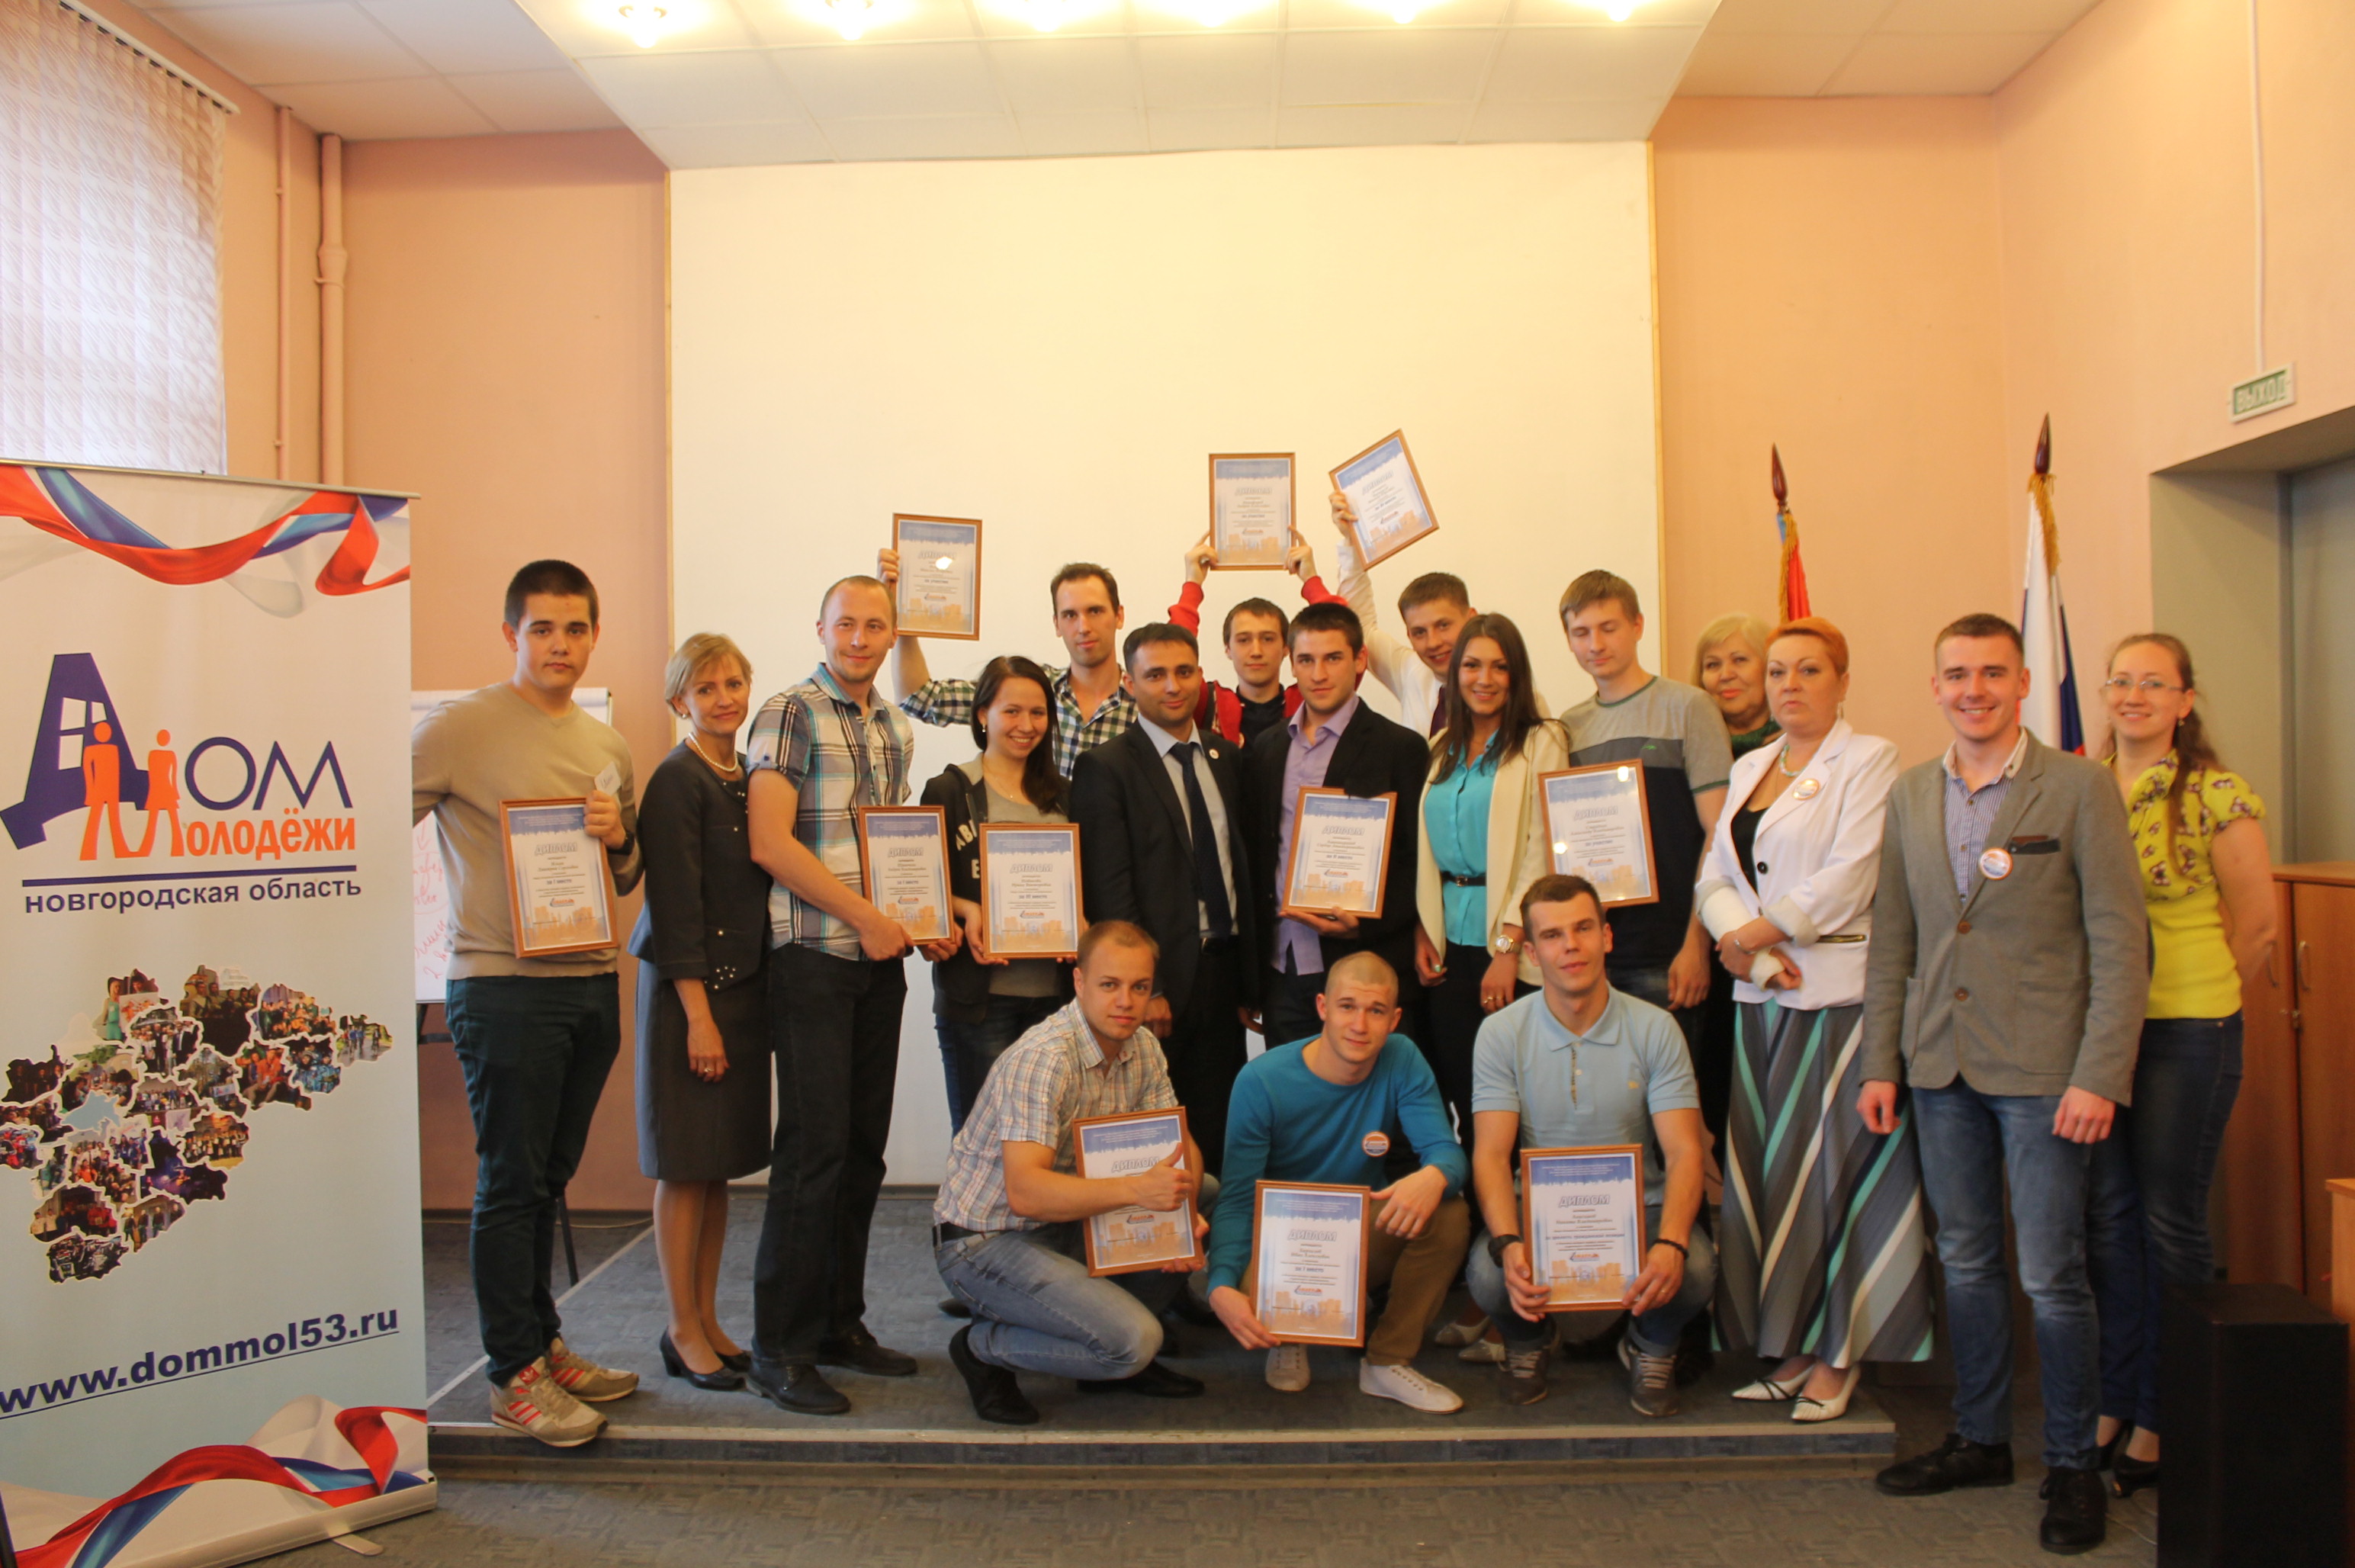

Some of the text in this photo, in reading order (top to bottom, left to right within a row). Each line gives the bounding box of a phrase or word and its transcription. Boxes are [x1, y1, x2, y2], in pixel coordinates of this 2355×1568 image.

[24, 876, 362, 914] новгородская область
[1111, 1156, 1160, 1174] ДИПЛОМ
[1557, 1194, 1611, 1208] ДИПЛОМ
[1287, 1229, 1338, 1242] ДИПЛОМ
[0, 1309, 398, 1414] www.dommol53.ru
